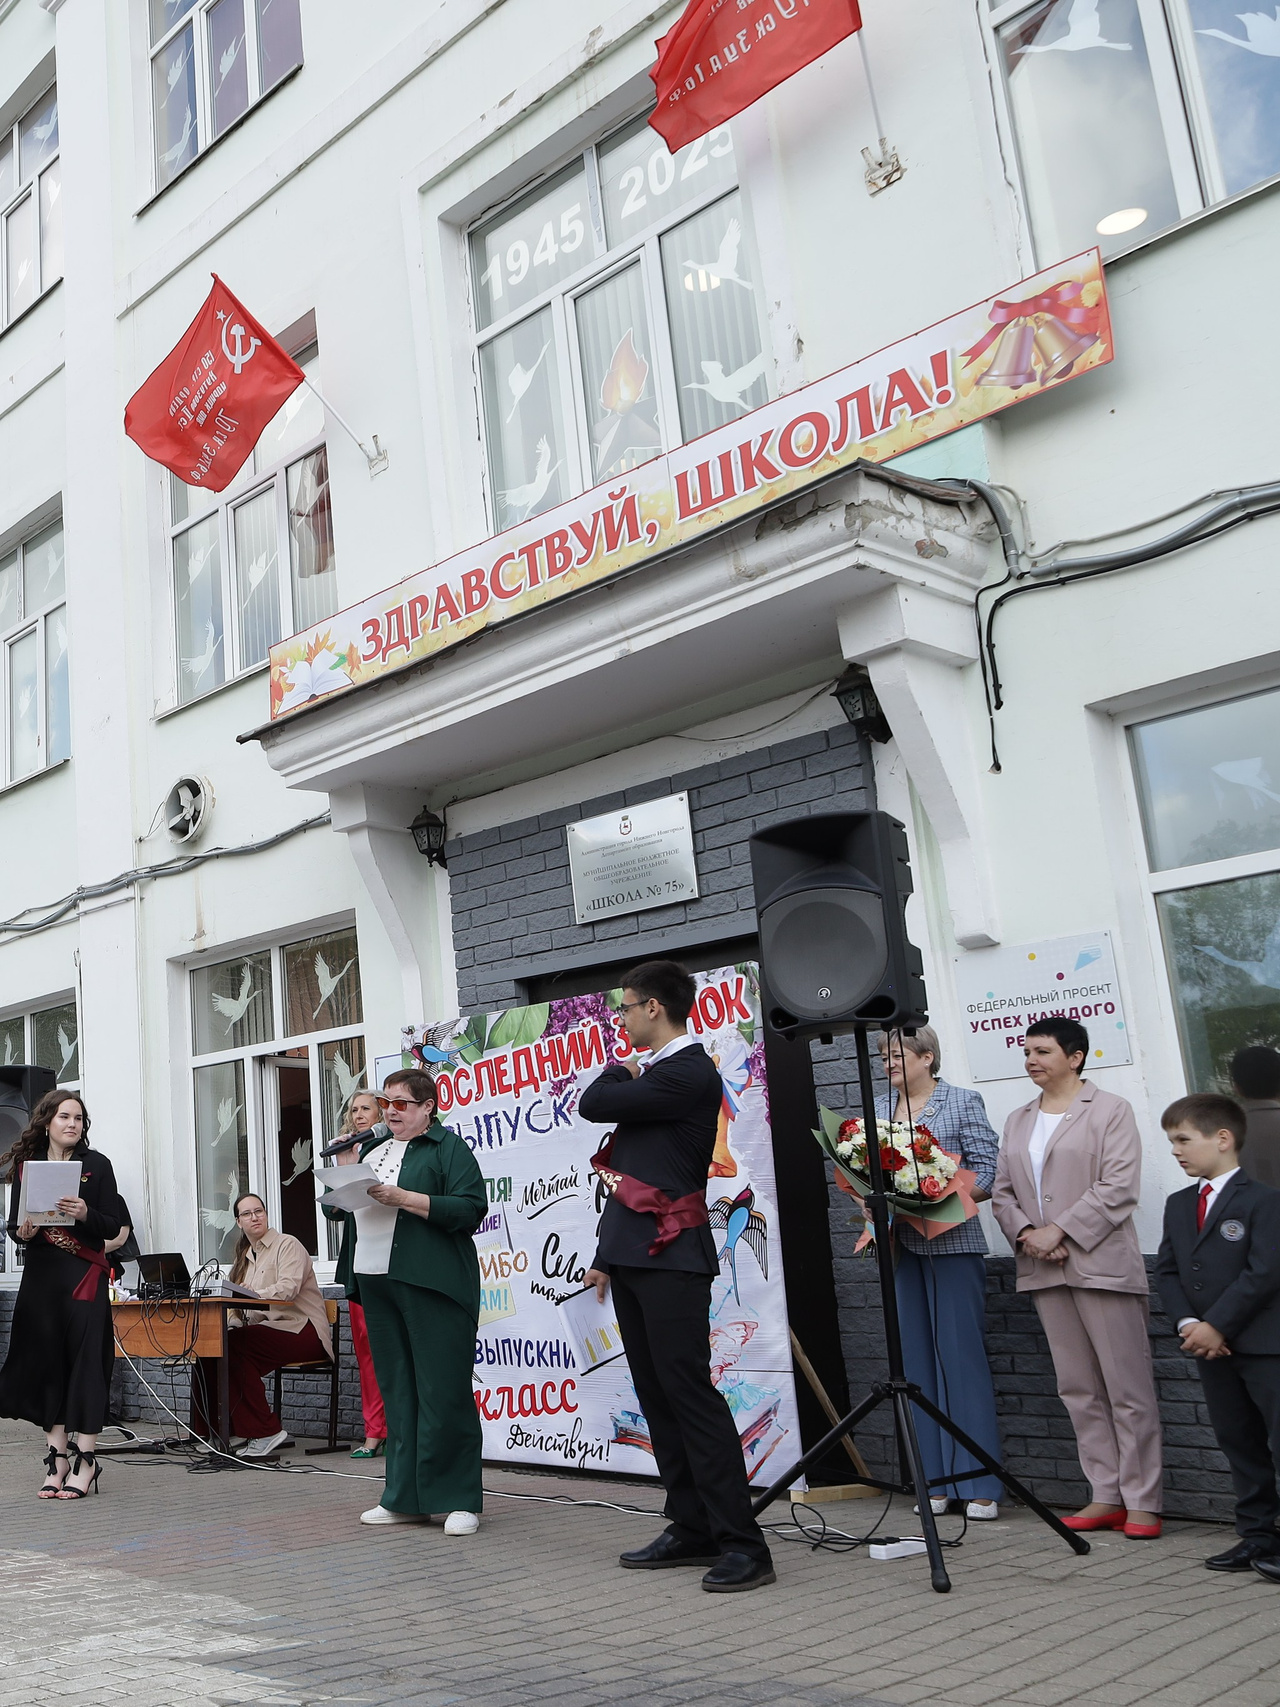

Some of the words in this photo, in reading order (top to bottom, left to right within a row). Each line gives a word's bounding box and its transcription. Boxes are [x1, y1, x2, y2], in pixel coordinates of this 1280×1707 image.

[481, 202, 585, 301] 1945
[361, 485, 658, 663] ЗДРАВСТВУЙ,
[674, 349, 953, 521] ШКОЛА!
[586, 889, 643, 912] «ШКОЛА
[664, 880, 685, 894] 75»
[966, 989, 1060, 1014] ФЕДЕРАЛЬНЫЙ
[1062, 982, 1112, 999] ПРОЕКТ
[970, 1014, 1024, 1033] УСПЕХ
[436, 1020, 605, 1111] ОСЛЕДНИЙ
[443, 1087, 575, 1151] ЫПУСК
[516, 1164, 582, 1213] Мечтай
[479, 1250, 529, 1281] ИБО
[480, 1288, 508, 1311] АМ!
[474, 1338, 576, 1370] ВЫПУСКНИ
[506, 1416, 610, 1469] Действуй!
